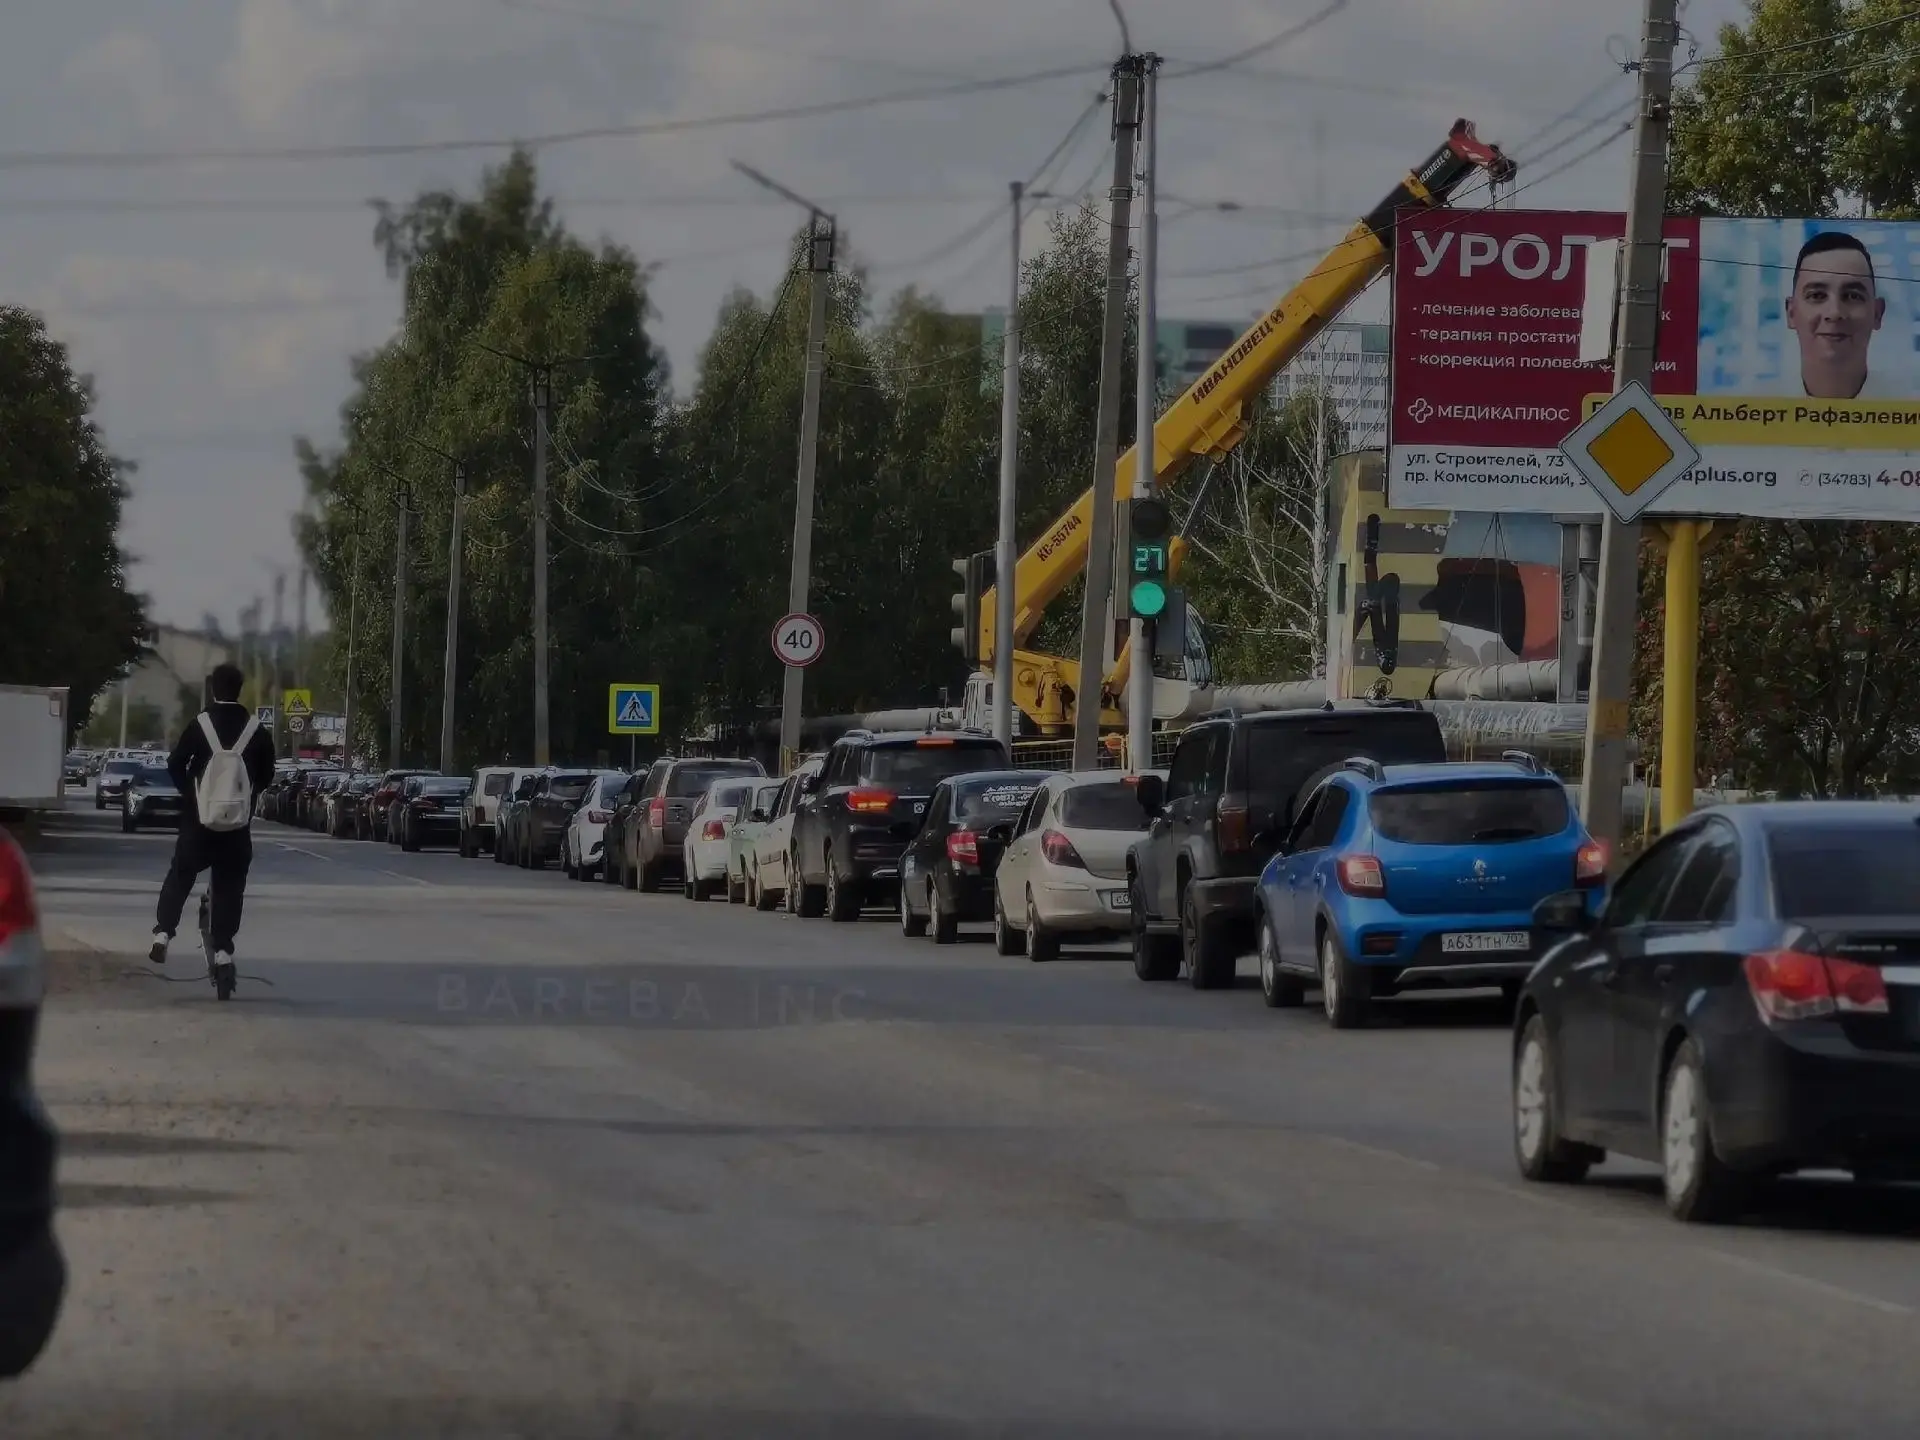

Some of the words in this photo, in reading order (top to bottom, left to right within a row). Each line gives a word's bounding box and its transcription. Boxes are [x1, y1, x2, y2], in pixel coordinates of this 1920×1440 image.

[1411, 231, 1690, 281] УРОЛГ
[1500, 304, 1582, 319] заболева
[1498, 331, 1580, 345] простати
[1192, 320, 1274, 405] ИВАНОВЕЦ
[1437, 404, 1571, 422] МЕДИКАПЛЮС
[1692, 403, 1788, 426] Альберт
[1795, 406, 1920, 427] Рафаэлеви
[1406, 453, 1430, 467] ул.
[1435, 452, 1541, 468] Строителей,
[1546, 455, 1564, 467] 73
[1405, 471, 1429, 484] пр.
[1434, 469, 1574, 487] Комсомольский,
[1681, 467, 1777, 487] aplus.org
[1818, 472, 1871, 488] (34783)
[1134, 546, 1164, 571] 27
[784, 629, 812, 649] 40
